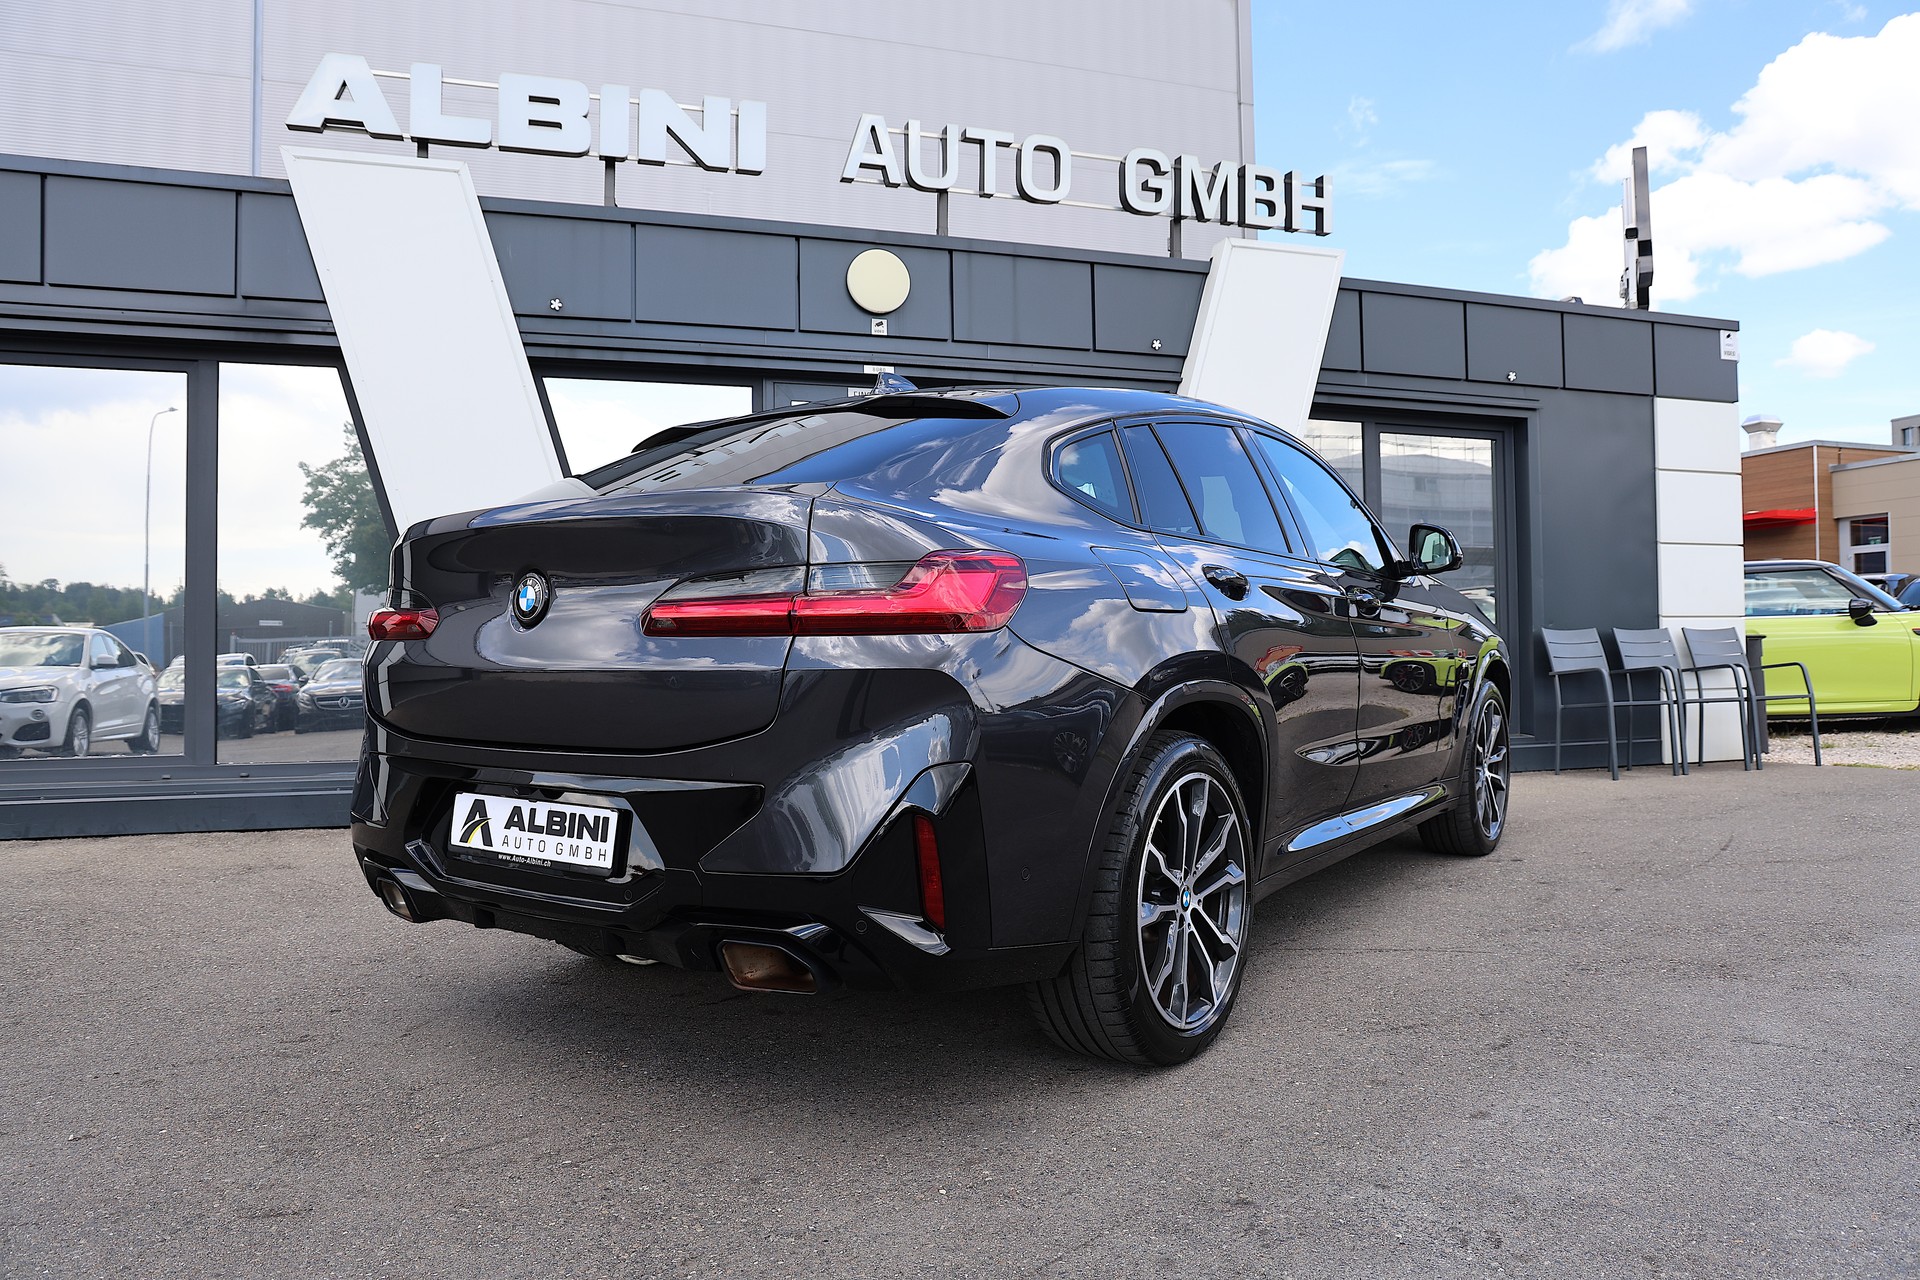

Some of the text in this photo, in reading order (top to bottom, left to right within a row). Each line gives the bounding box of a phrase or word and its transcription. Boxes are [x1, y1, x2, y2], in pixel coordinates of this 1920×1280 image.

[285, 52, 1334, 237] ALBINI AUTO GMBH
[504, 805, 611, 843] ALBINI
[497, 853, 552, 868] www.Auto-Albini.ch
[501, 834, 608, 862] AUTO GMBH
